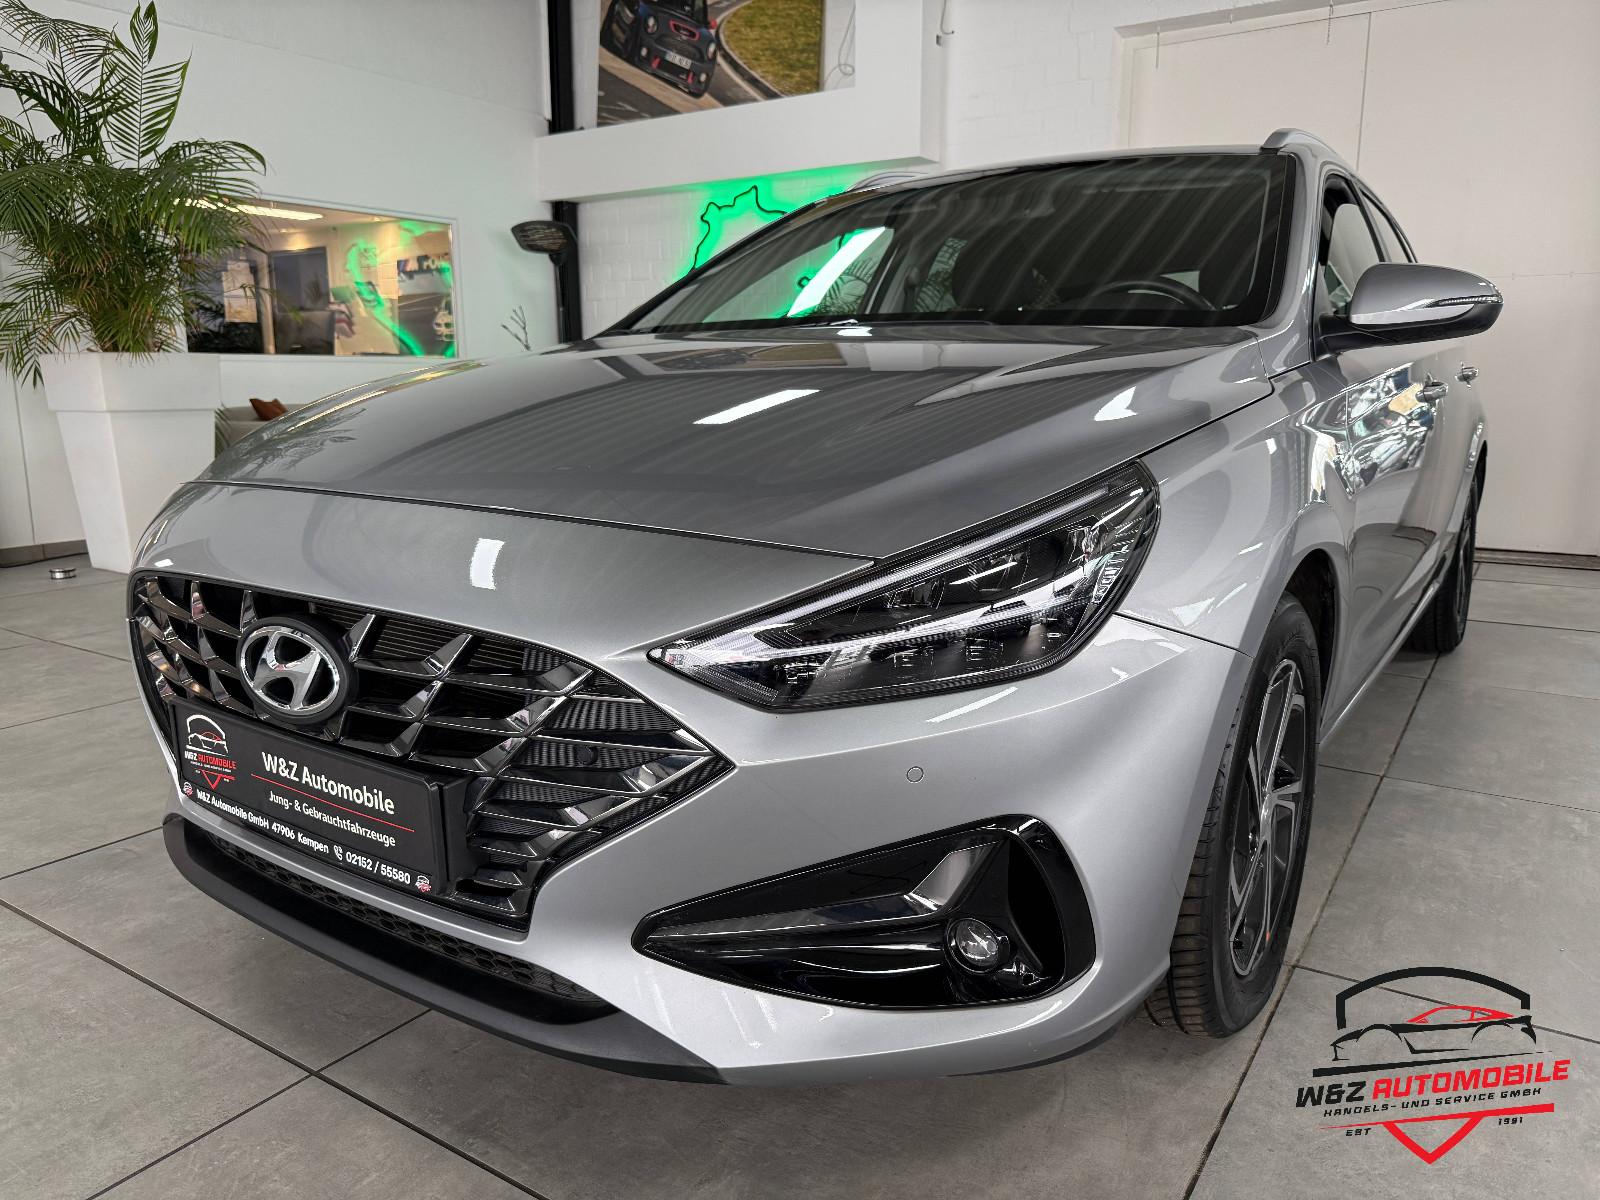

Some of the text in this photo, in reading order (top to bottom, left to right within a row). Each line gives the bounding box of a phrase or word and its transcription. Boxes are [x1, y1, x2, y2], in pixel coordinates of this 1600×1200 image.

[261, 752, 395, 815] W&Z Automobile
[196, 789, 211, 804] W&Z
[211, 796, 248, 820] Automobile
[248, 813, 270, 830] GmbH
[271, 822, 296, 840] 47906
[297, 833, 330, 854] Kempen
[345, 851, 373, 870] 02152
[380, 865, 411, 885] 55580
[269, 791, 396, 847] Jung- & Gebrauchtfahrzeuge
